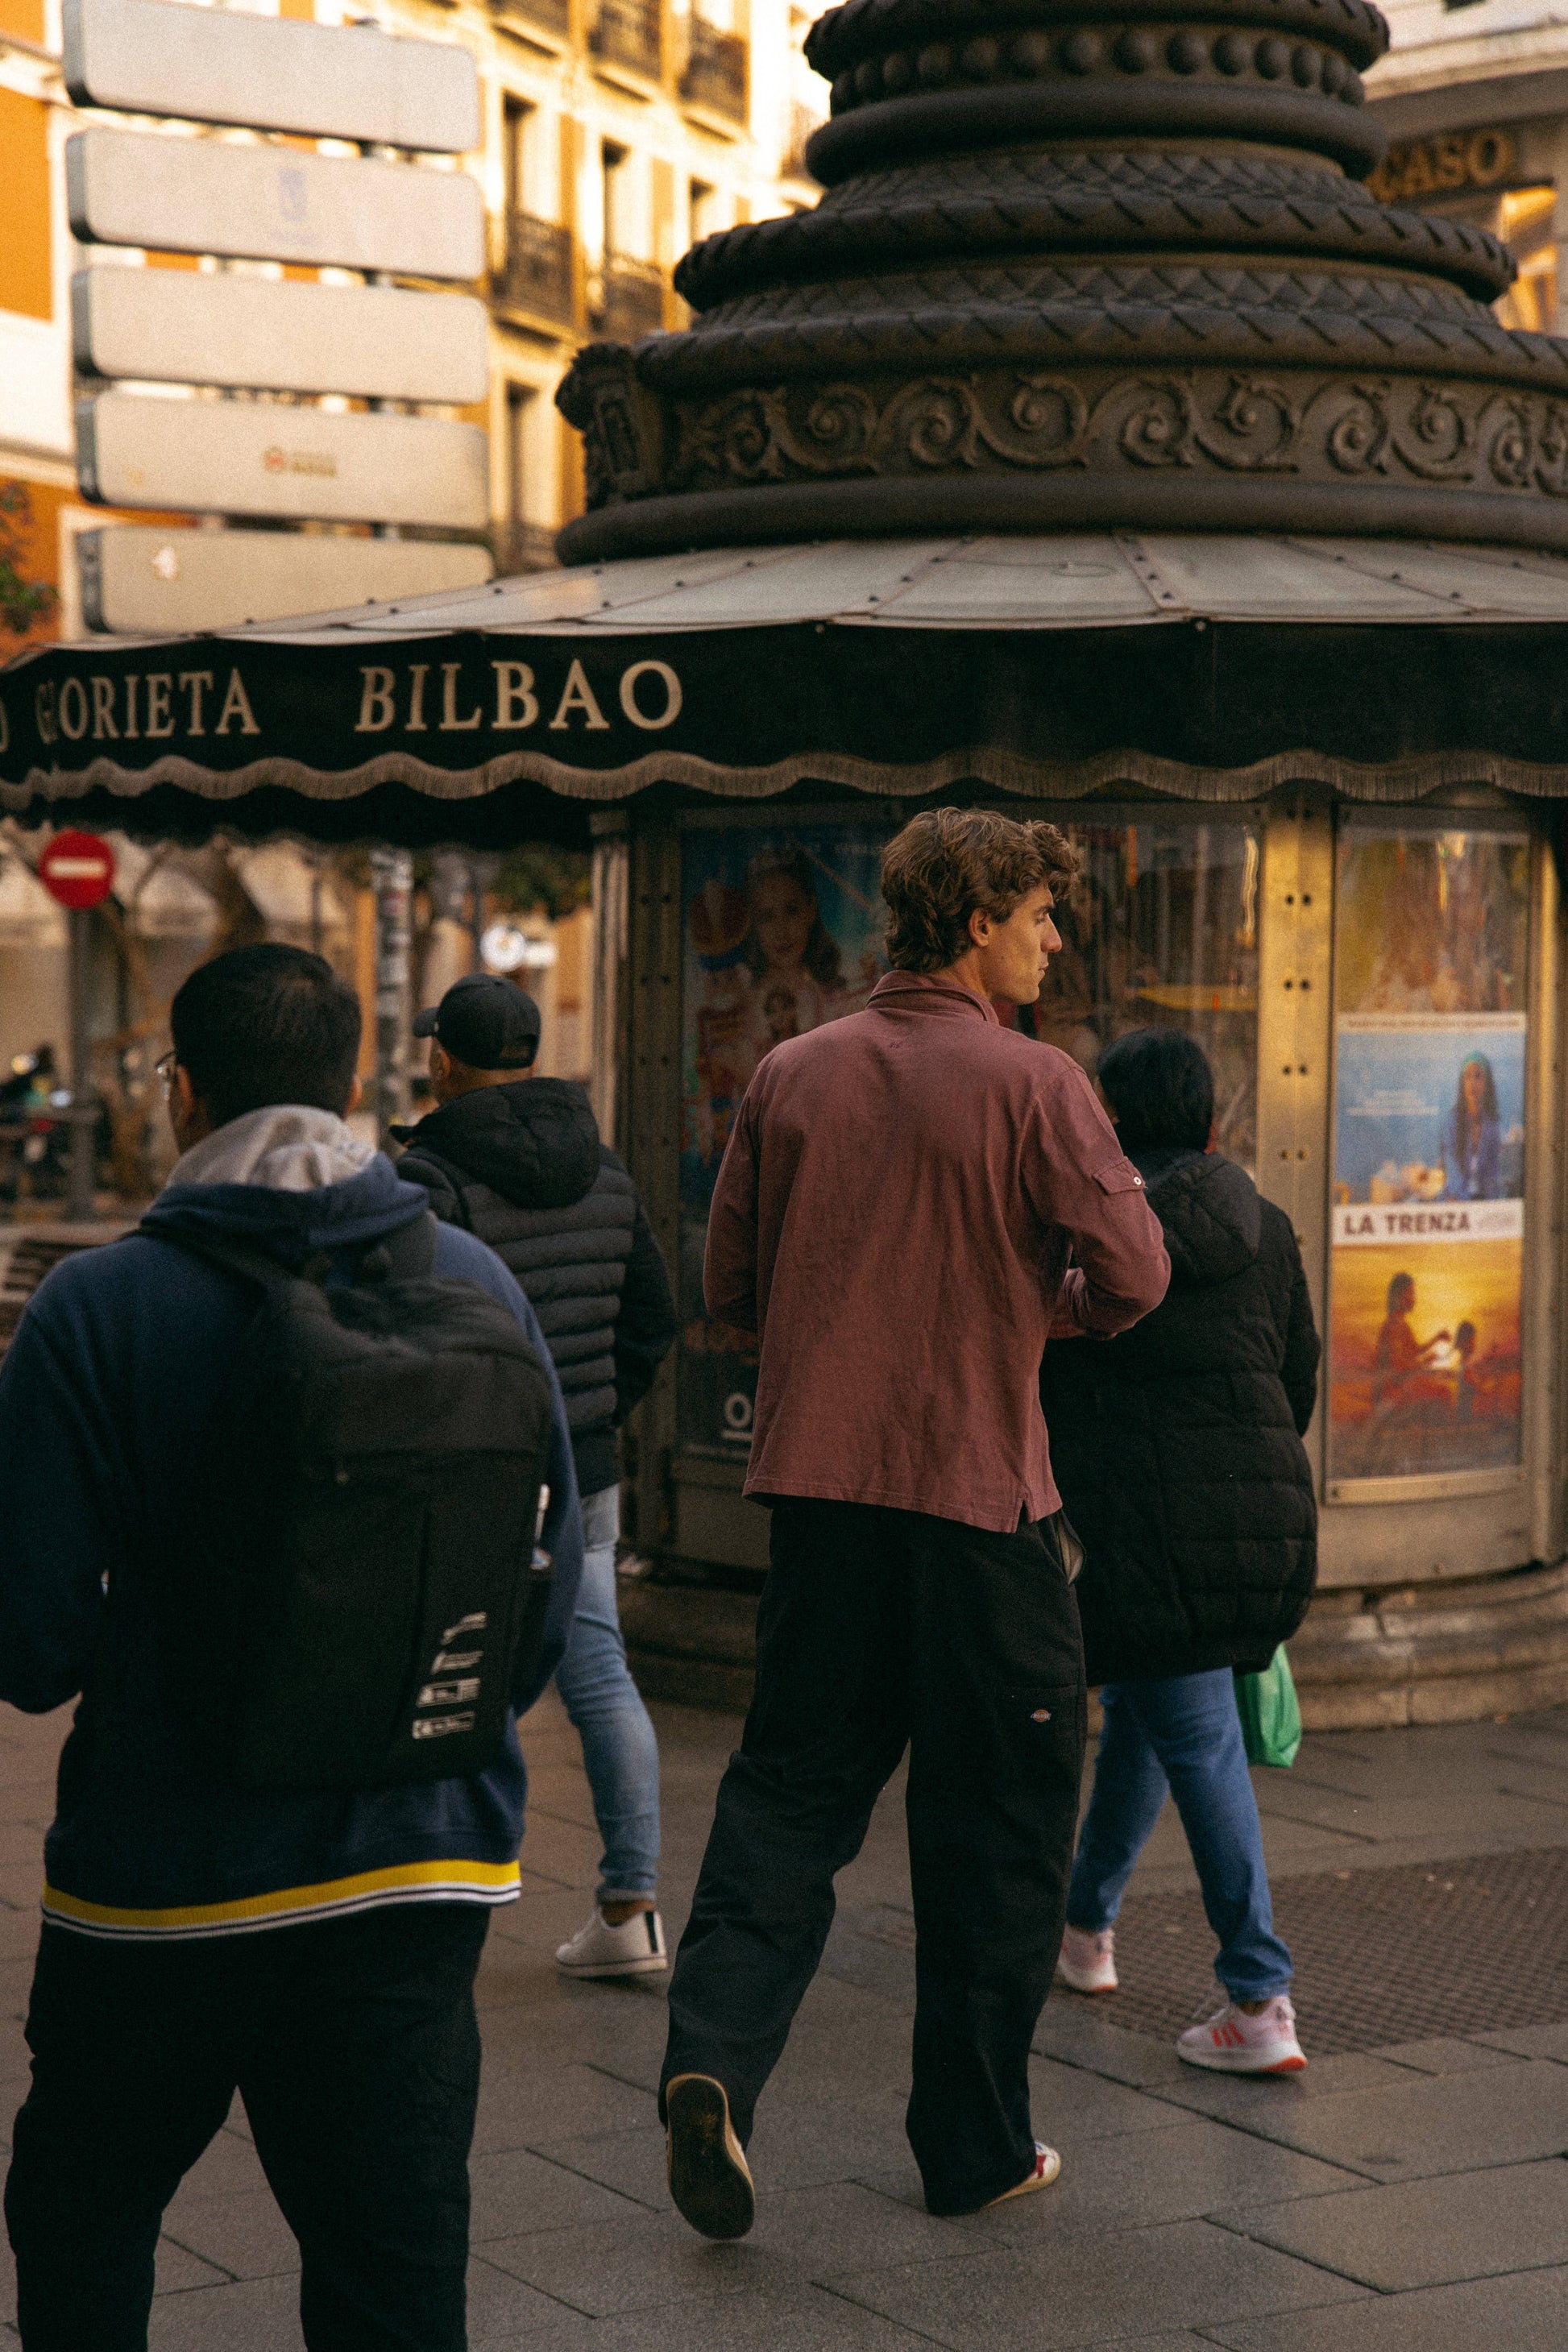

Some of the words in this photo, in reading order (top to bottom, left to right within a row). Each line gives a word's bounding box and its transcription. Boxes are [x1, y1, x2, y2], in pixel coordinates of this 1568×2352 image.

[355, 657, 683, 732] BILBAO
[1344, 1214, 1375, 1235] LA
[1385, 1212, 1471, 1234] TRENZA
